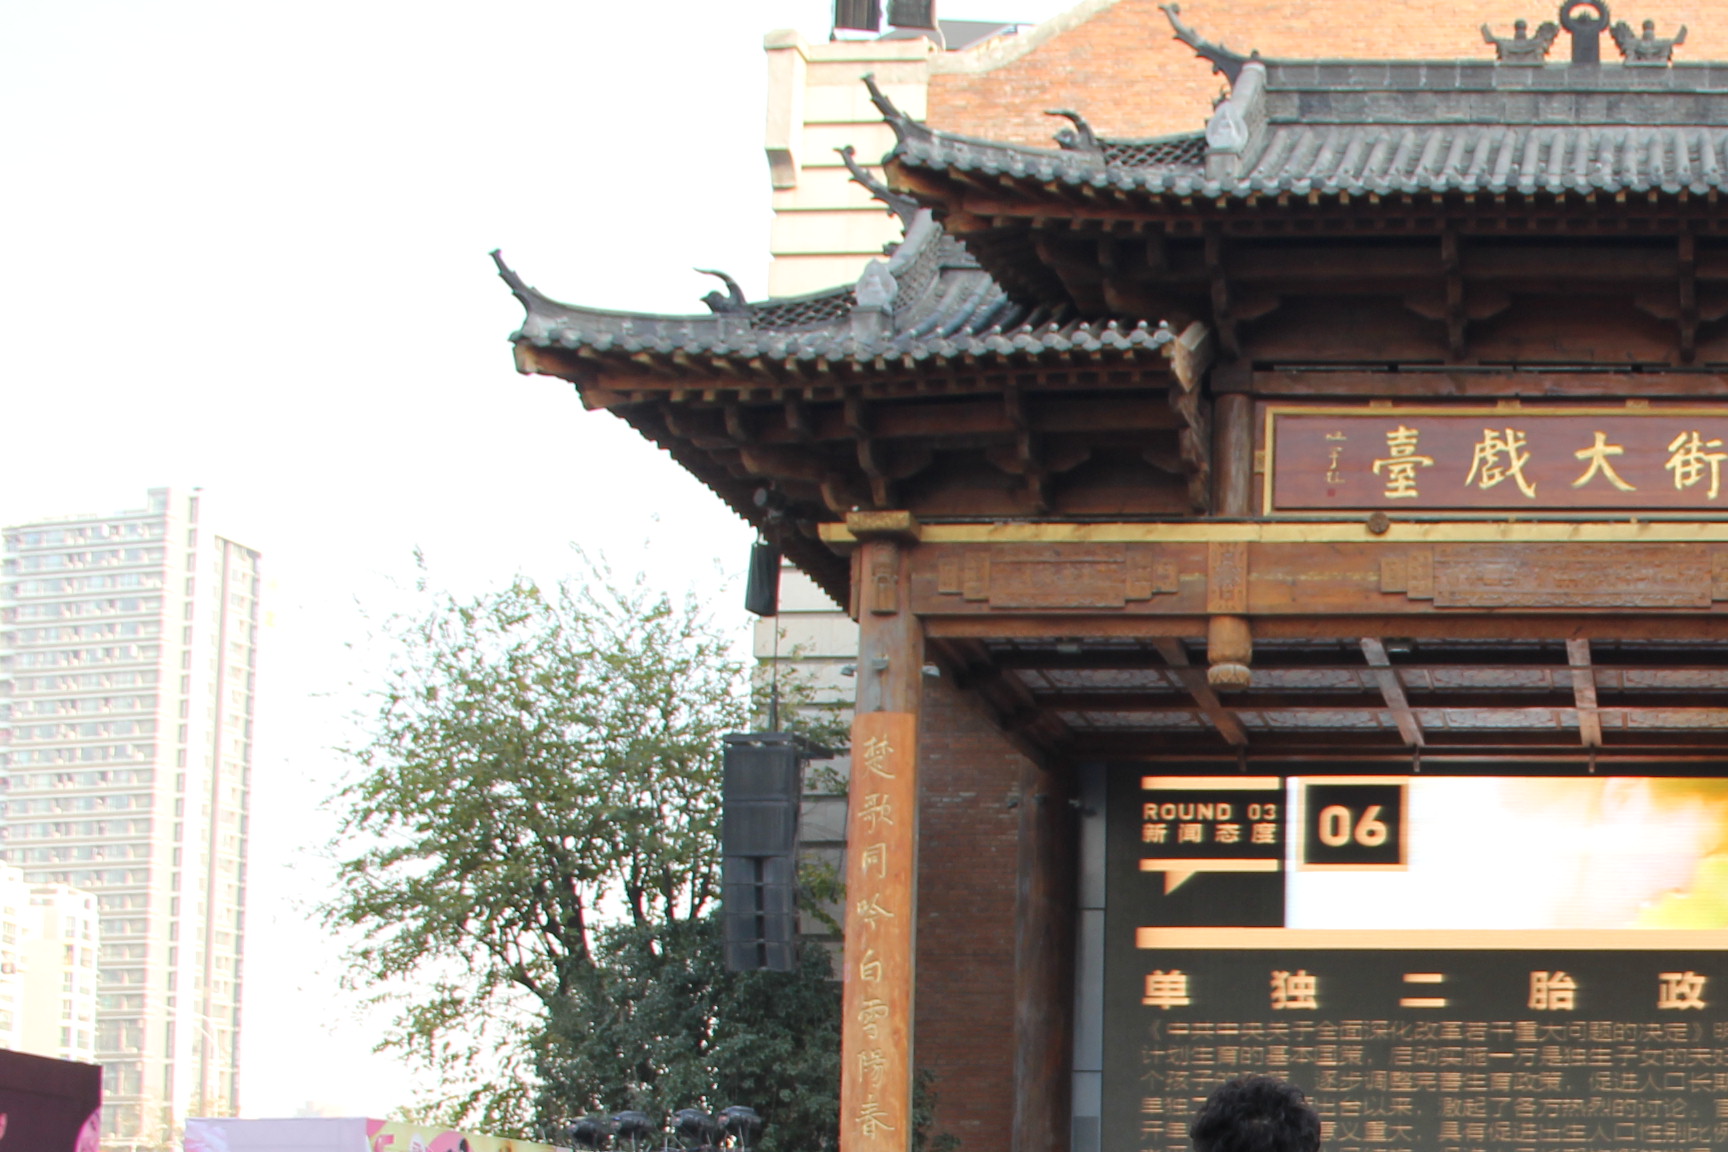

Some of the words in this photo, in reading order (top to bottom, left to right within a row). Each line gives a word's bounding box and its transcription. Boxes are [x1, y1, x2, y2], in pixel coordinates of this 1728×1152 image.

[1143, 803, 1231, 820] ROUND
[1247, 803, 1277, 820] 03
[1142, 823, 1276, 844] 新闻态度
[1319, 804, 1387, 847] 06
